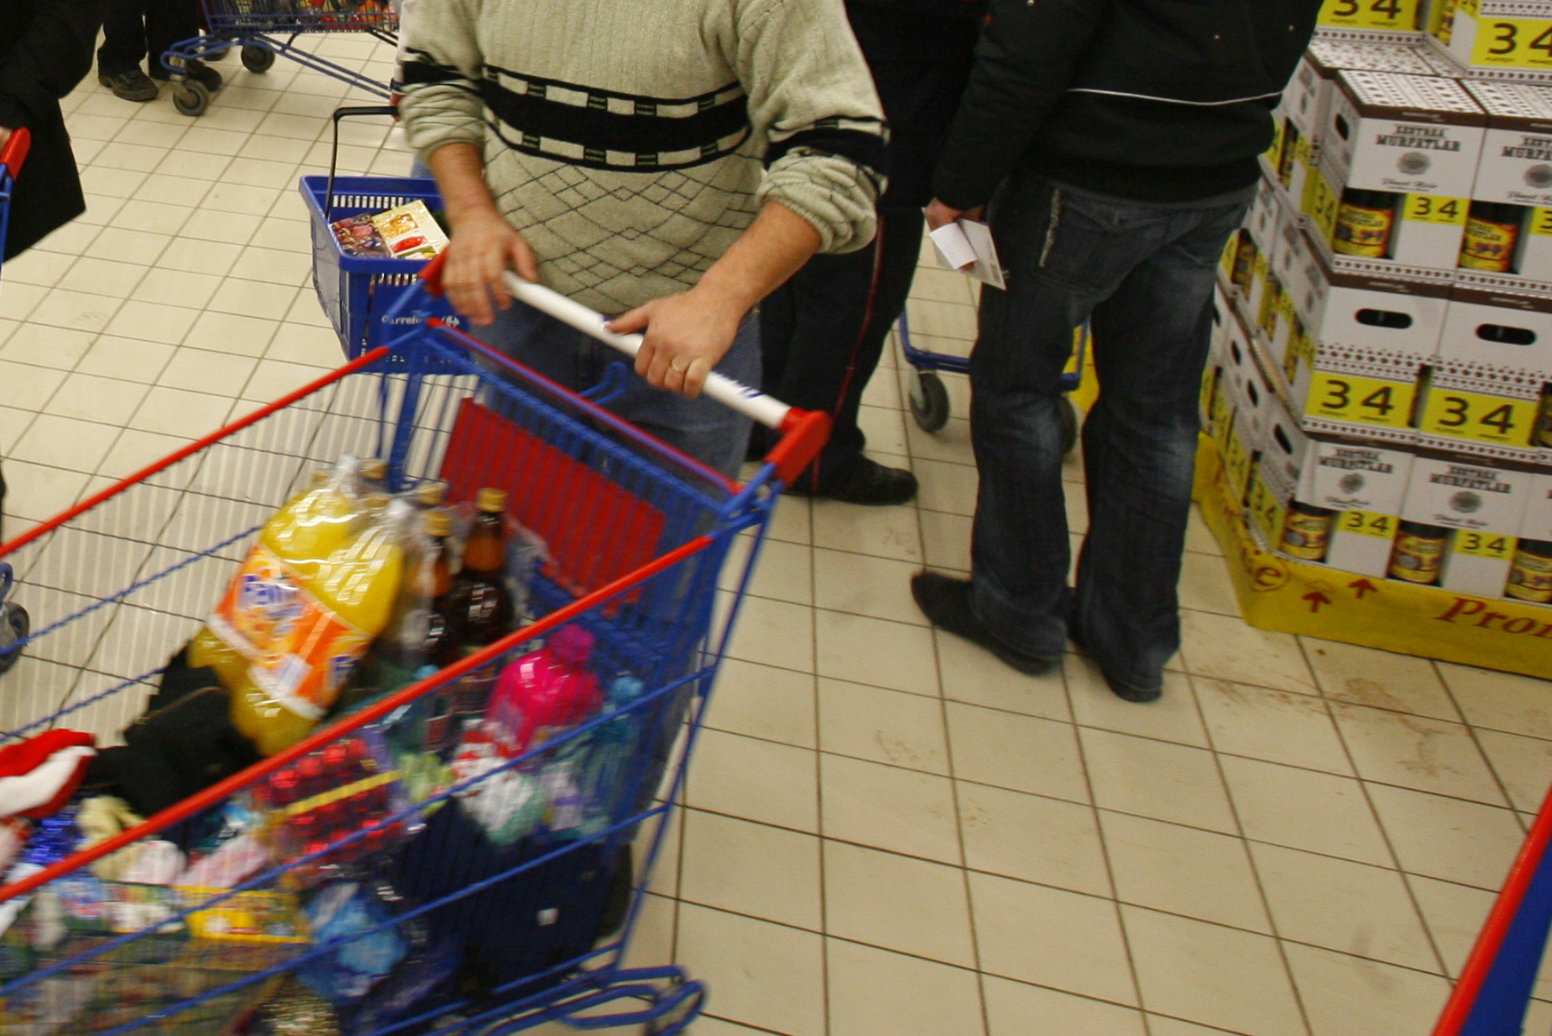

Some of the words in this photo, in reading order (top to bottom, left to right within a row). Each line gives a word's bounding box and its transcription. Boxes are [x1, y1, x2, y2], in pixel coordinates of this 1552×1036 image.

[1487, 22, 1552, 59] 34
[1413, 196, 1459, 219] 34
[1321, 379, 1395, 416] 34
[1438, 396, 1515, 435] 34
[1347, 511, 1389, 533] 34
[1463, 533, 1506, 554] 34
